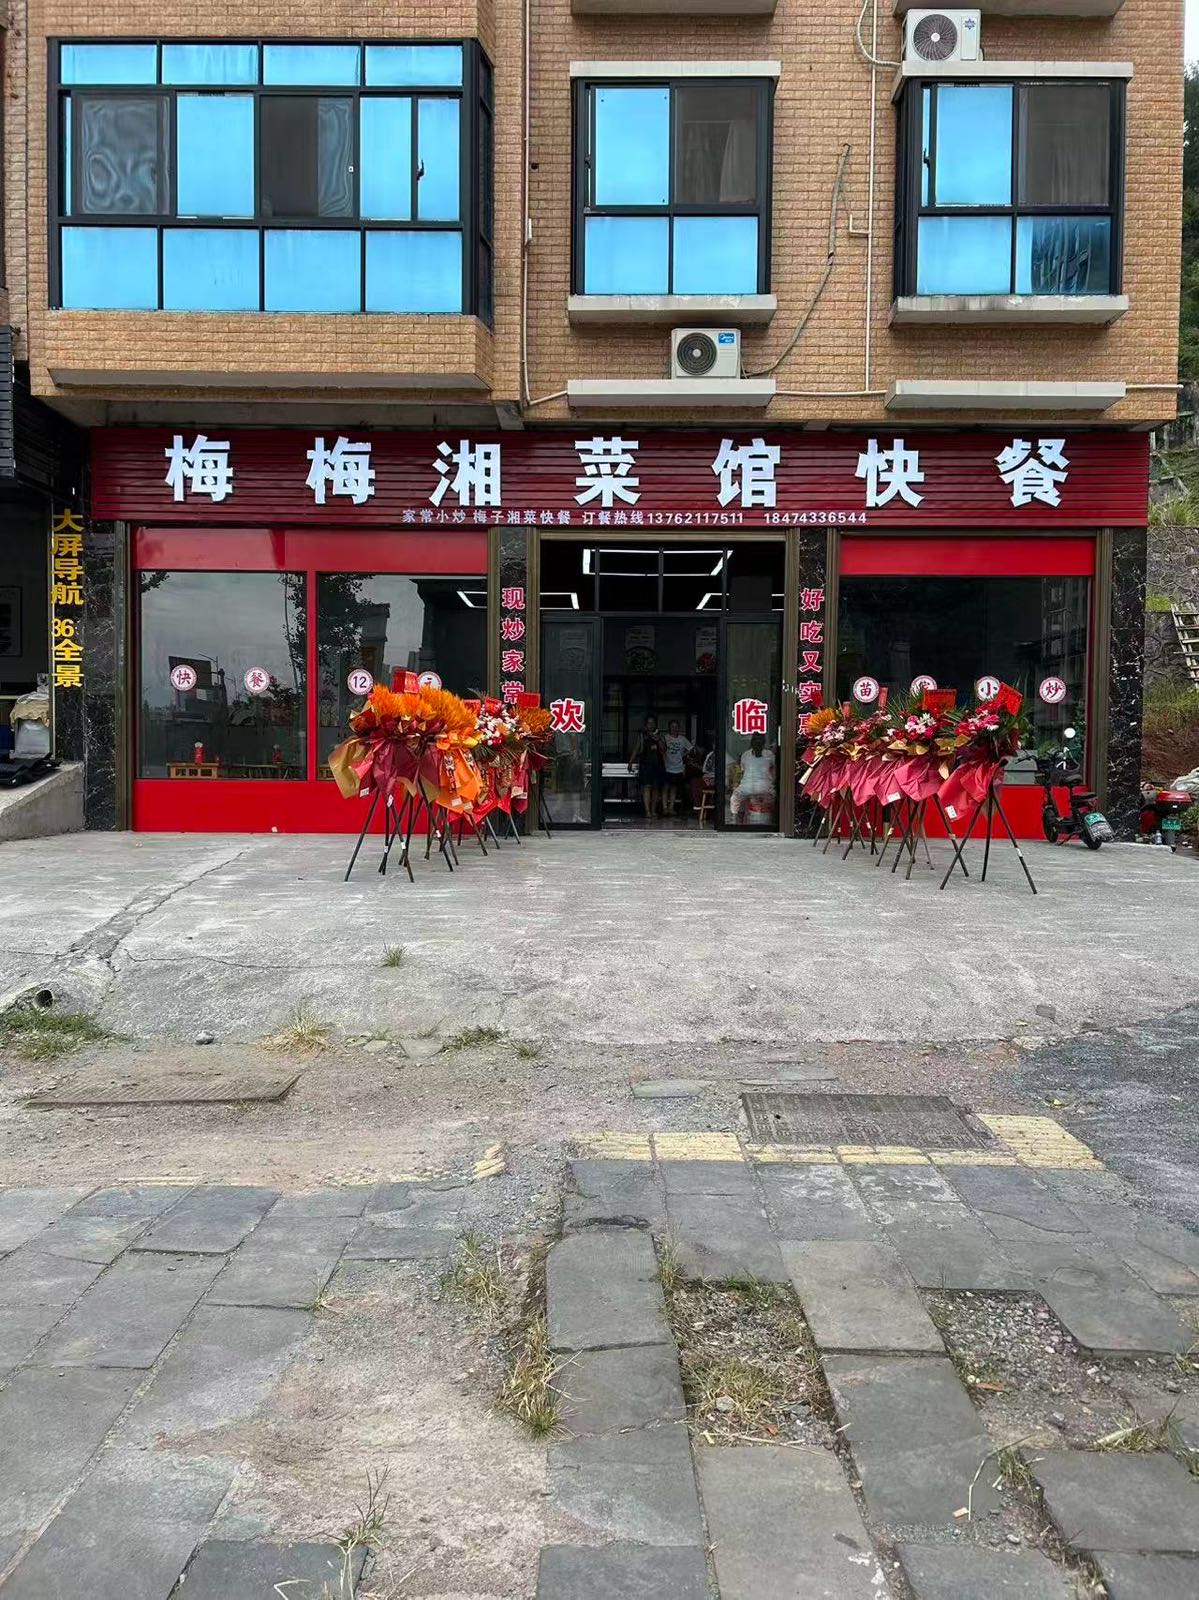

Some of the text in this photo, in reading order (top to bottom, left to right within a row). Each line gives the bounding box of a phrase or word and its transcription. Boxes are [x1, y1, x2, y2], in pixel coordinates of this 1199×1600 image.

[165, 434, 1069, 508] 梅梅湘菜馆快餐
[402, 509, 467, 525] 家常小炒
[473, 509, 571, 525] 梅子湘菜快餐
[763, 511, 868, 525] 18474336544
[51, 508, 84, 606] 大屏导航
[550, 698, 586, 733] 欢
[733, 699, 768, 735] 临
